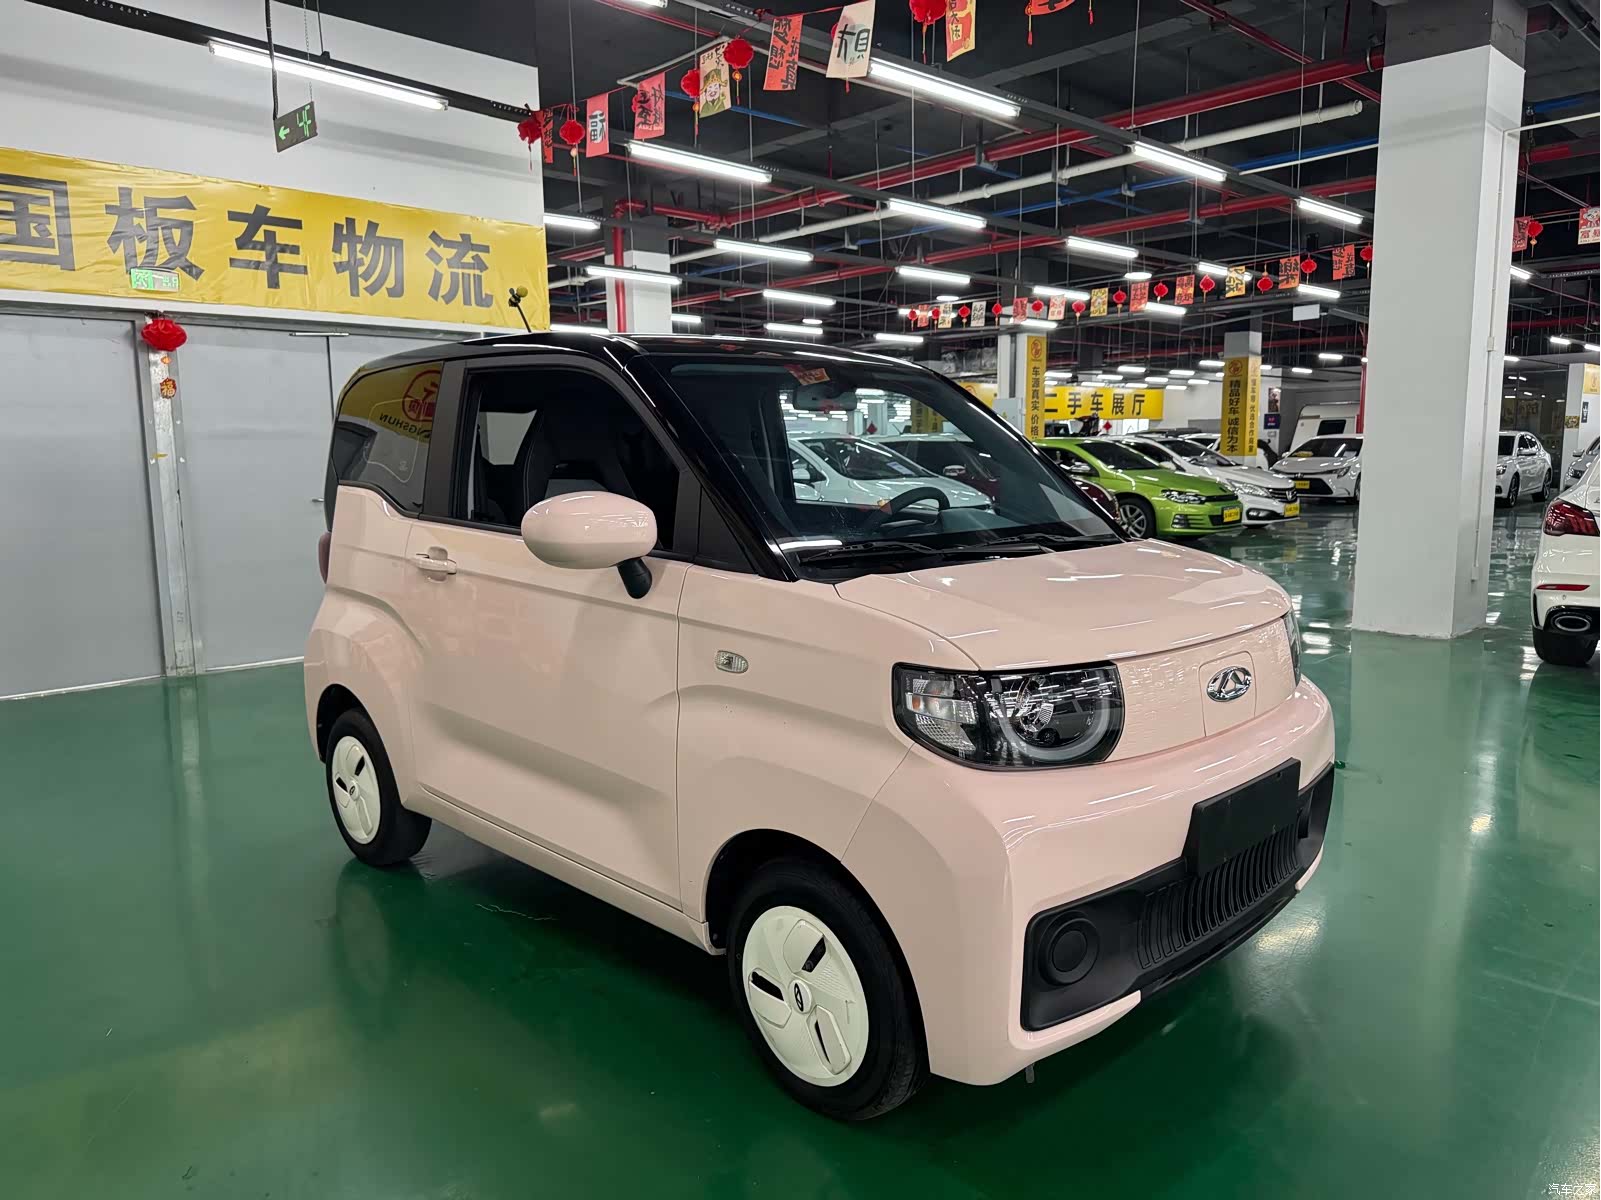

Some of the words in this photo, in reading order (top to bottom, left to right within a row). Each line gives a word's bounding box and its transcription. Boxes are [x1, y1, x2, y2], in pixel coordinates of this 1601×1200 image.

[0, 173, 494, 308] 国板车物流
[161, 380, 176, 397] 福
[1044, 392, 1146, 416] 二手车展厅
[1030, 415, 1039, 440] 价格
